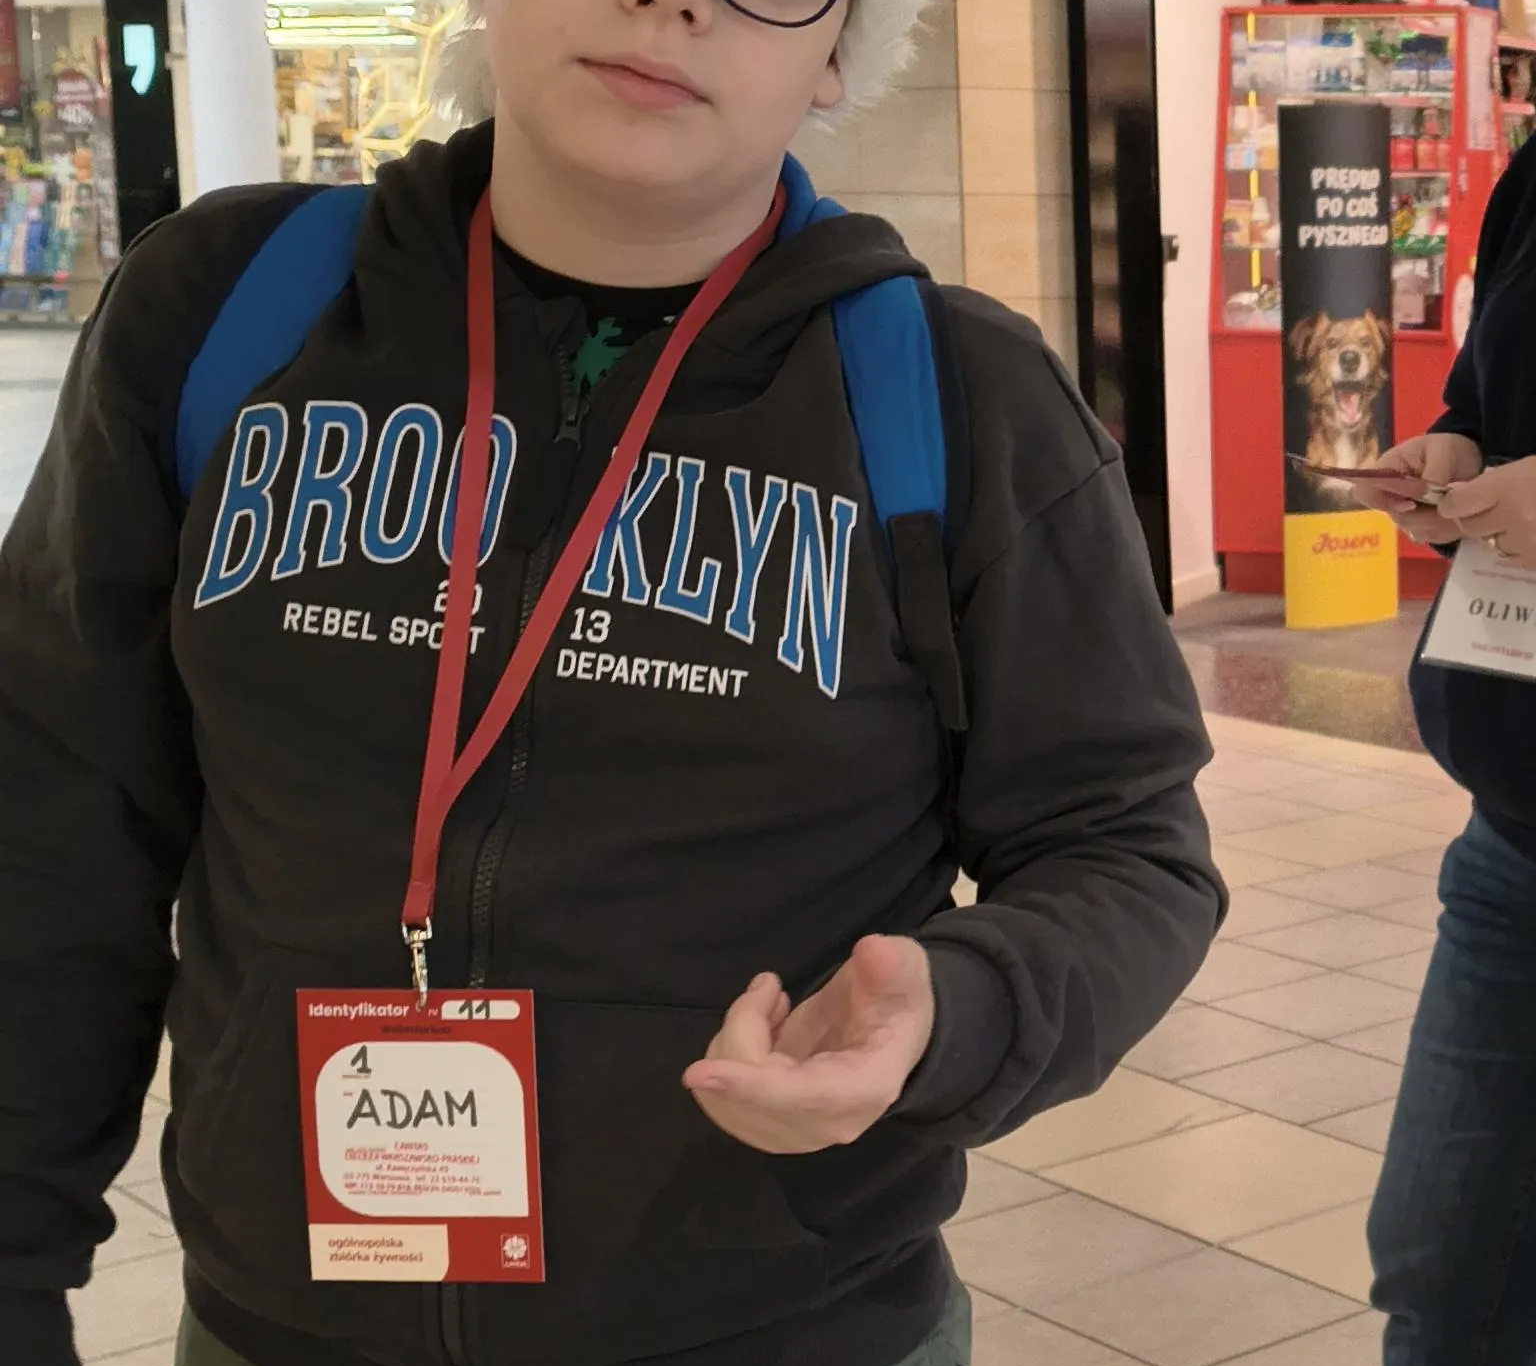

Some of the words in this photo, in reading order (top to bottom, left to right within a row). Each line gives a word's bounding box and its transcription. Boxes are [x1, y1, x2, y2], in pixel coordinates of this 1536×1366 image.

[1310, 167, 1382, 193] PRĘDKO
[1316, 197, 1344, 219] PO
[1346, 191, 1379, 218] COŚ
[1298, 224, 1390, 249] PYSZNEGO
[569, 606, 613, 645] 13
[283, 601, 379, 642] REBEL
[388, 615, 487, 655] SPOT
[556, 647, 750, 698] DEPARTMENT
[308, 1001, 410, 1020] Identyfikator
[458, 1000, 491, 1020] 11
[350, 1045, 372, 1074] 1
[346, 1088, 478, 1129] ADAM
